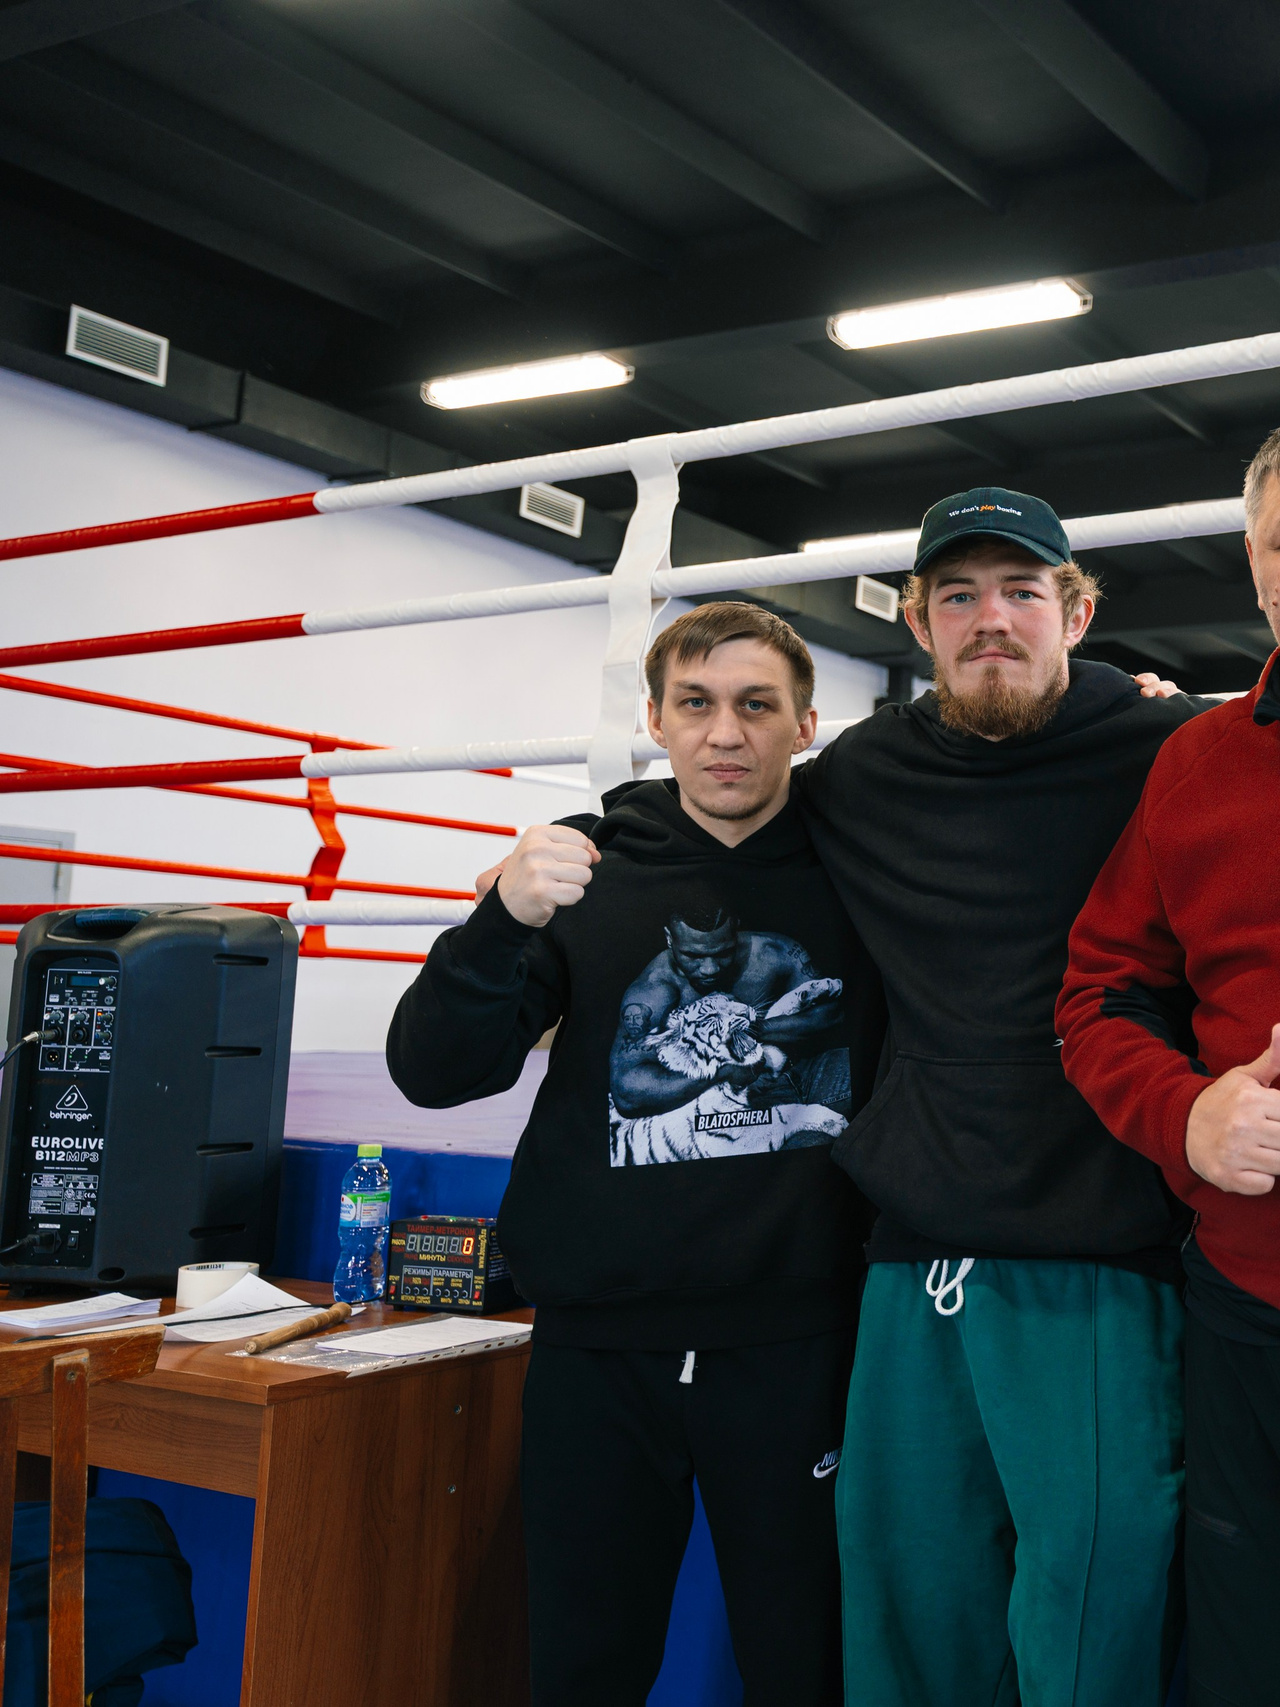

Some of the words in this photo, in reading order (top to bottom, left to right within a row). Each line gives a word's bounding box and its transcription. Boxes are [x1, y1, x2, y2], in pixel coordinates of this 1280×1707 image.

[961, 505, 979, 514] don't
[980, 504, 996, 512] play
[996, 504, 1022, 517] boxing
[49, 1110, 92, 1122] behringer
[697, 1109, 769, 1130] BLATOSPHERA
[31, 1136, 104, 1150] EUROLIVE
[419, 1253, 446, 1262] МИНУТЫ
[404, 1267, 432, 1276] РЕЖИМЫ
[433, 1269, 472, 1279] ПАРАМЕТРЫ
